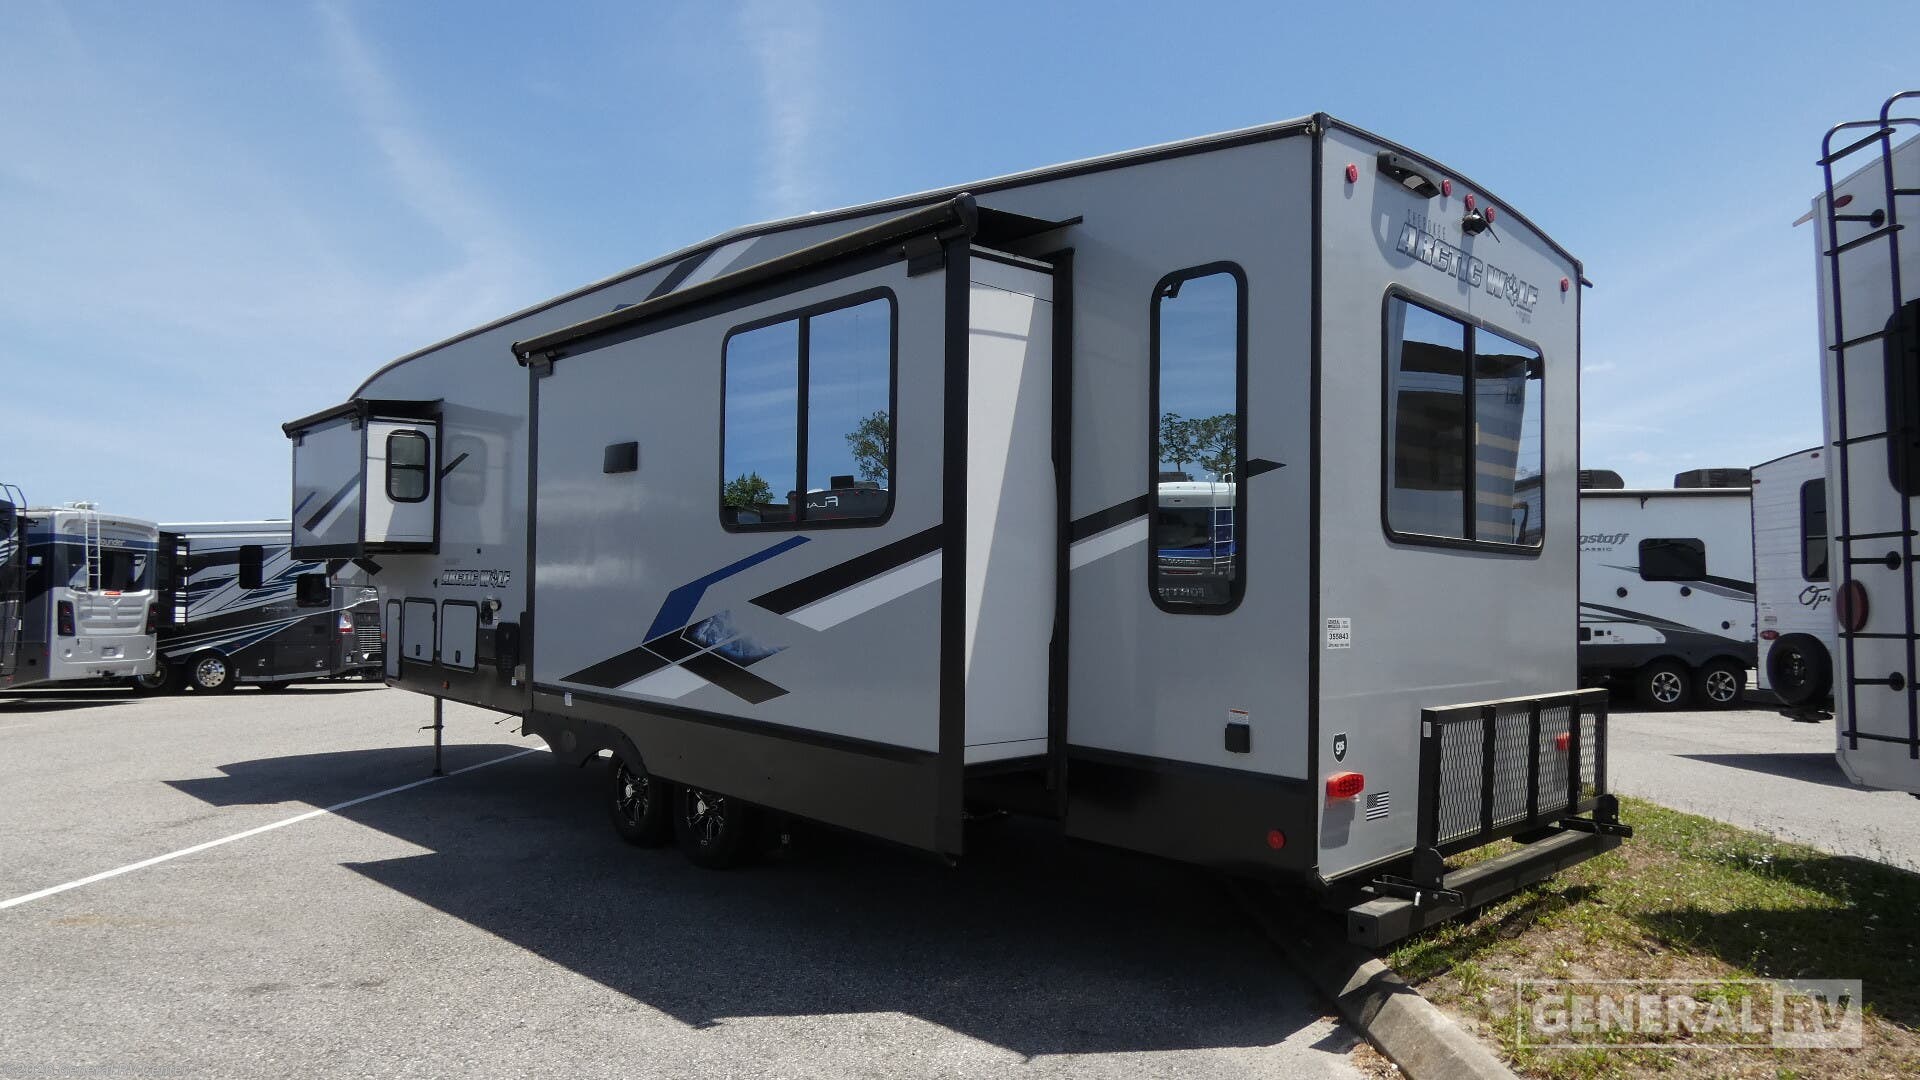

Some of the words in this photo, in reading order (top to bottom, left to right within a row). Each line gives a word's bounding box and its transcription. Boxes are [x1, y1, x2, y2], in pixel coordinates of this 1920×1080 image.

[1396, 222, 1484, 289] ARCTIC
[1579, 533, 1630, 545] gstaff
[440, 569, 479, 587] ARCTIC
